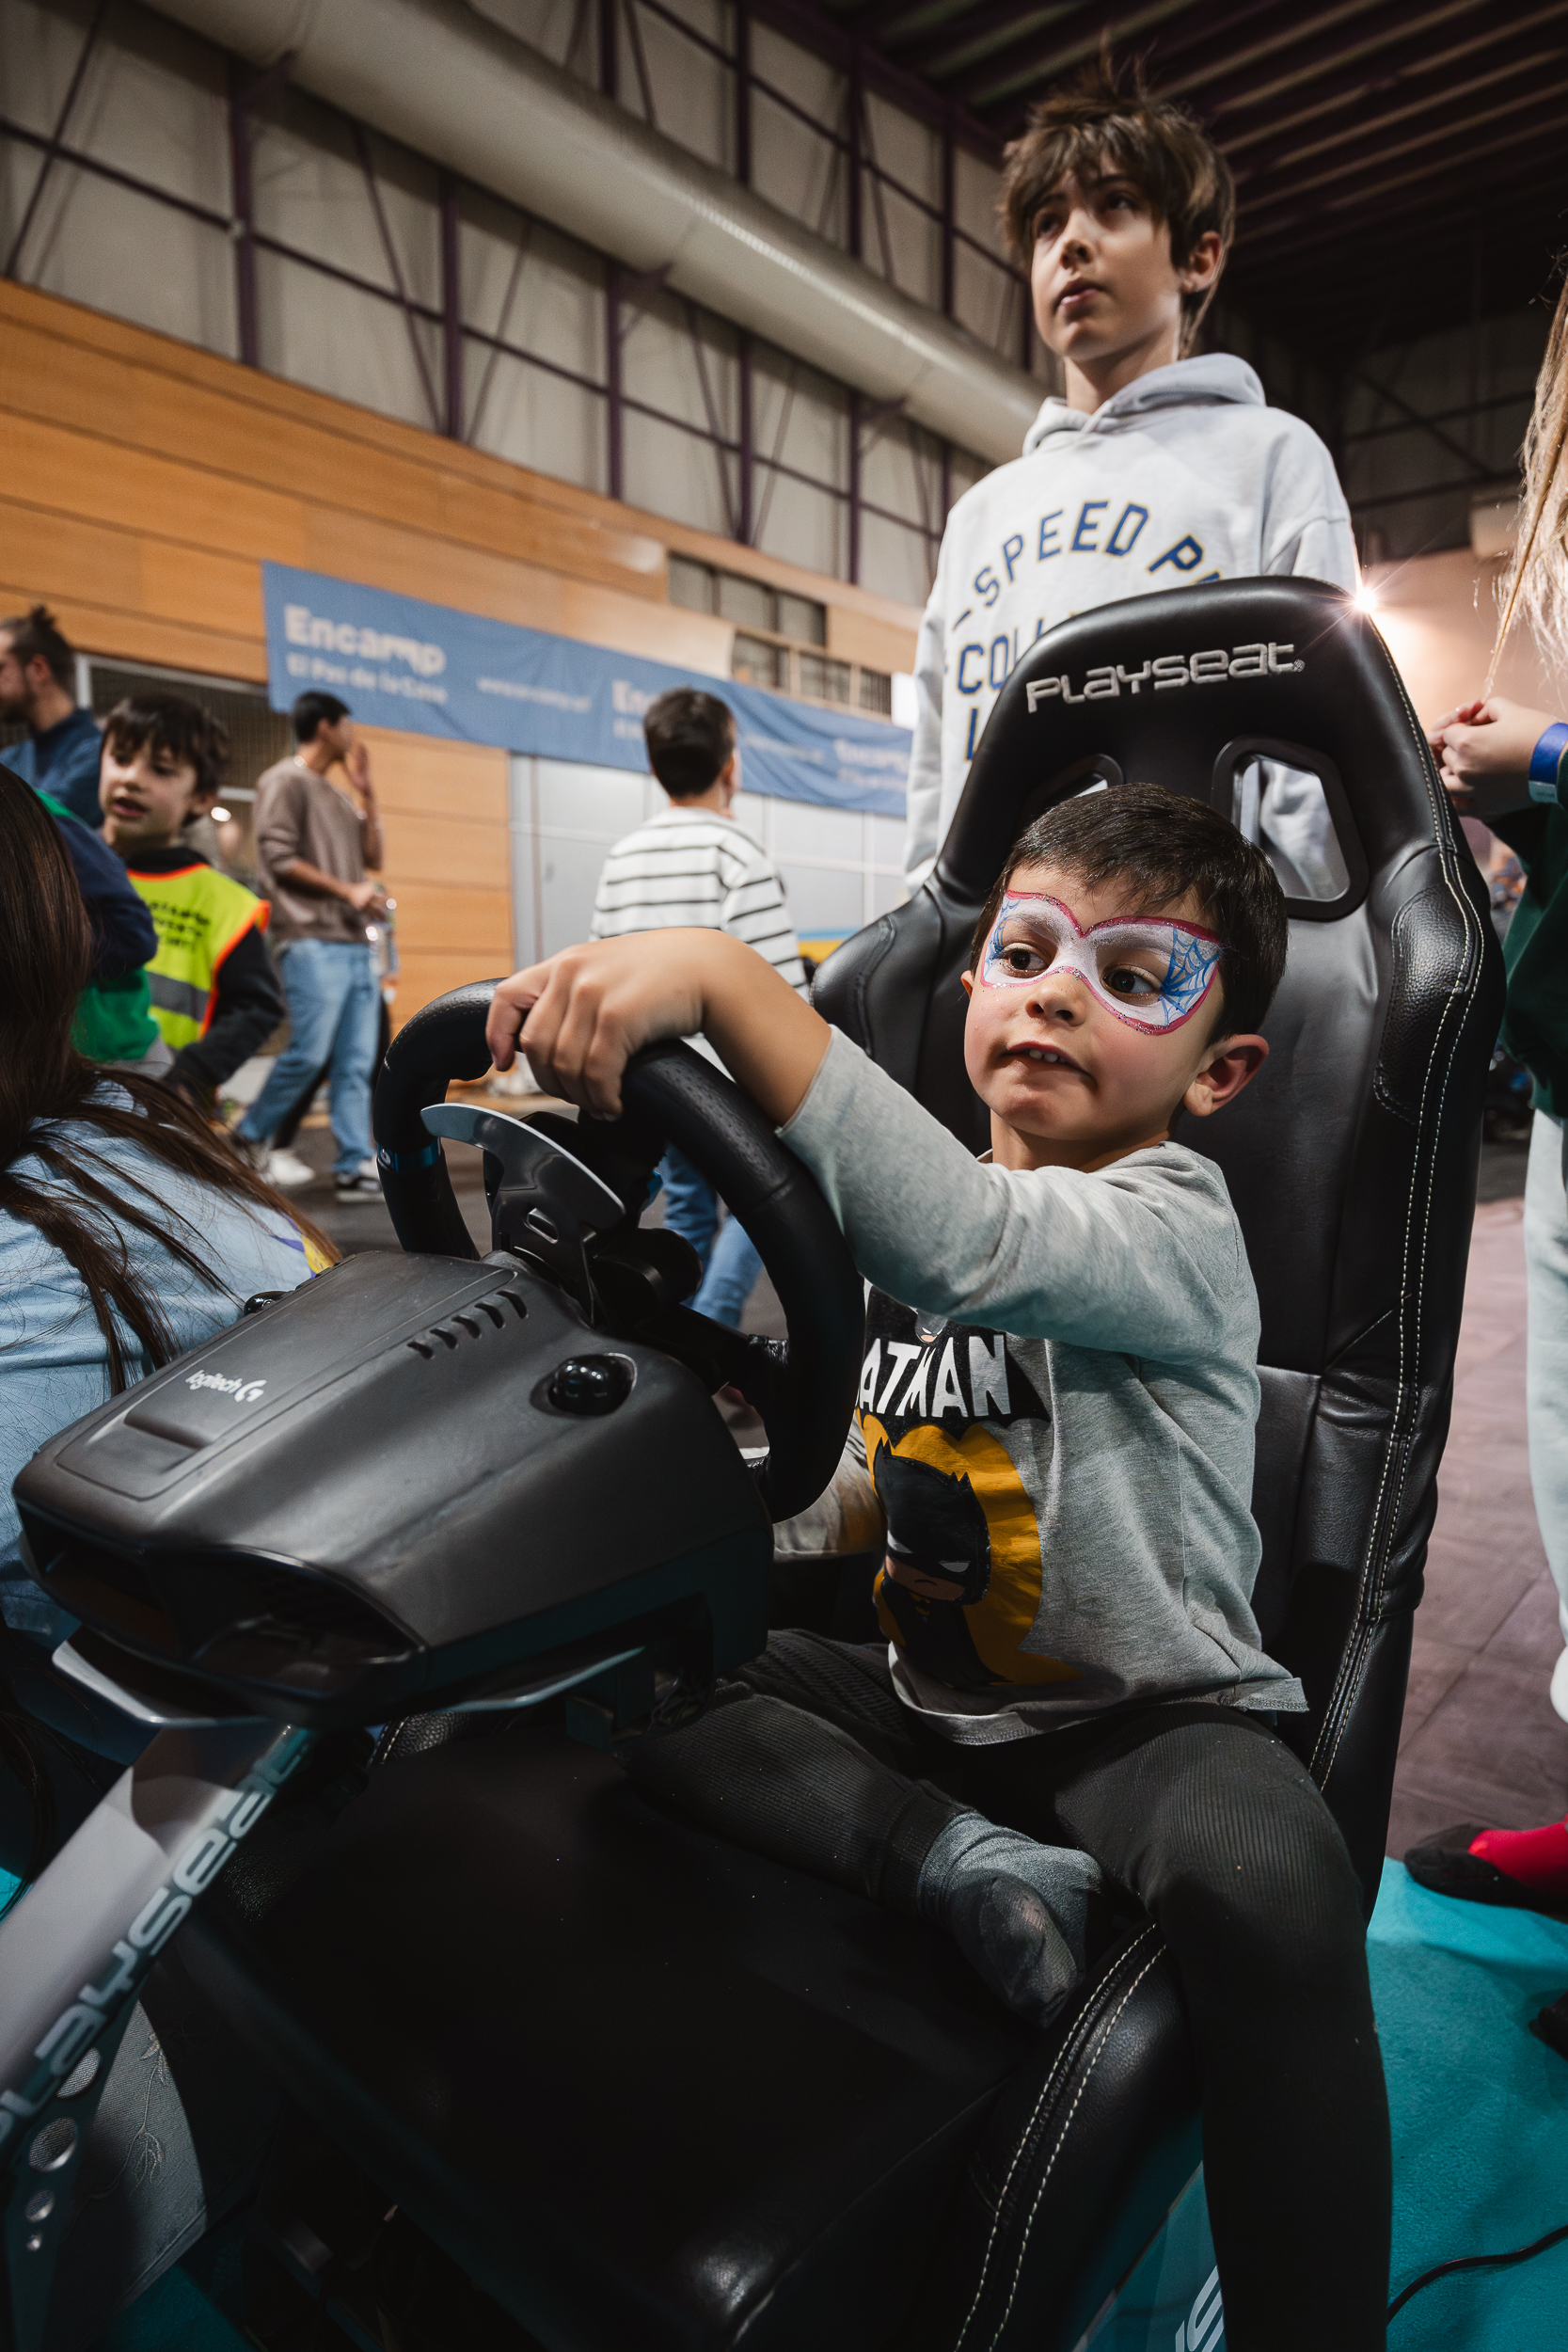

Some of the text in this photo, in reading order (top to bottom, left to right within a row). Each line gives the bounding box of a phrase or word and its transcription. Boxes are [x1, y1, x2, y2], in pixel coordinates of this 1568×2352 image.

[974, 501, 1224, 608] SPEED P
[284, 603, 448, 677] Encamp
[859, 1335, 1011, 1418] ATMAN
